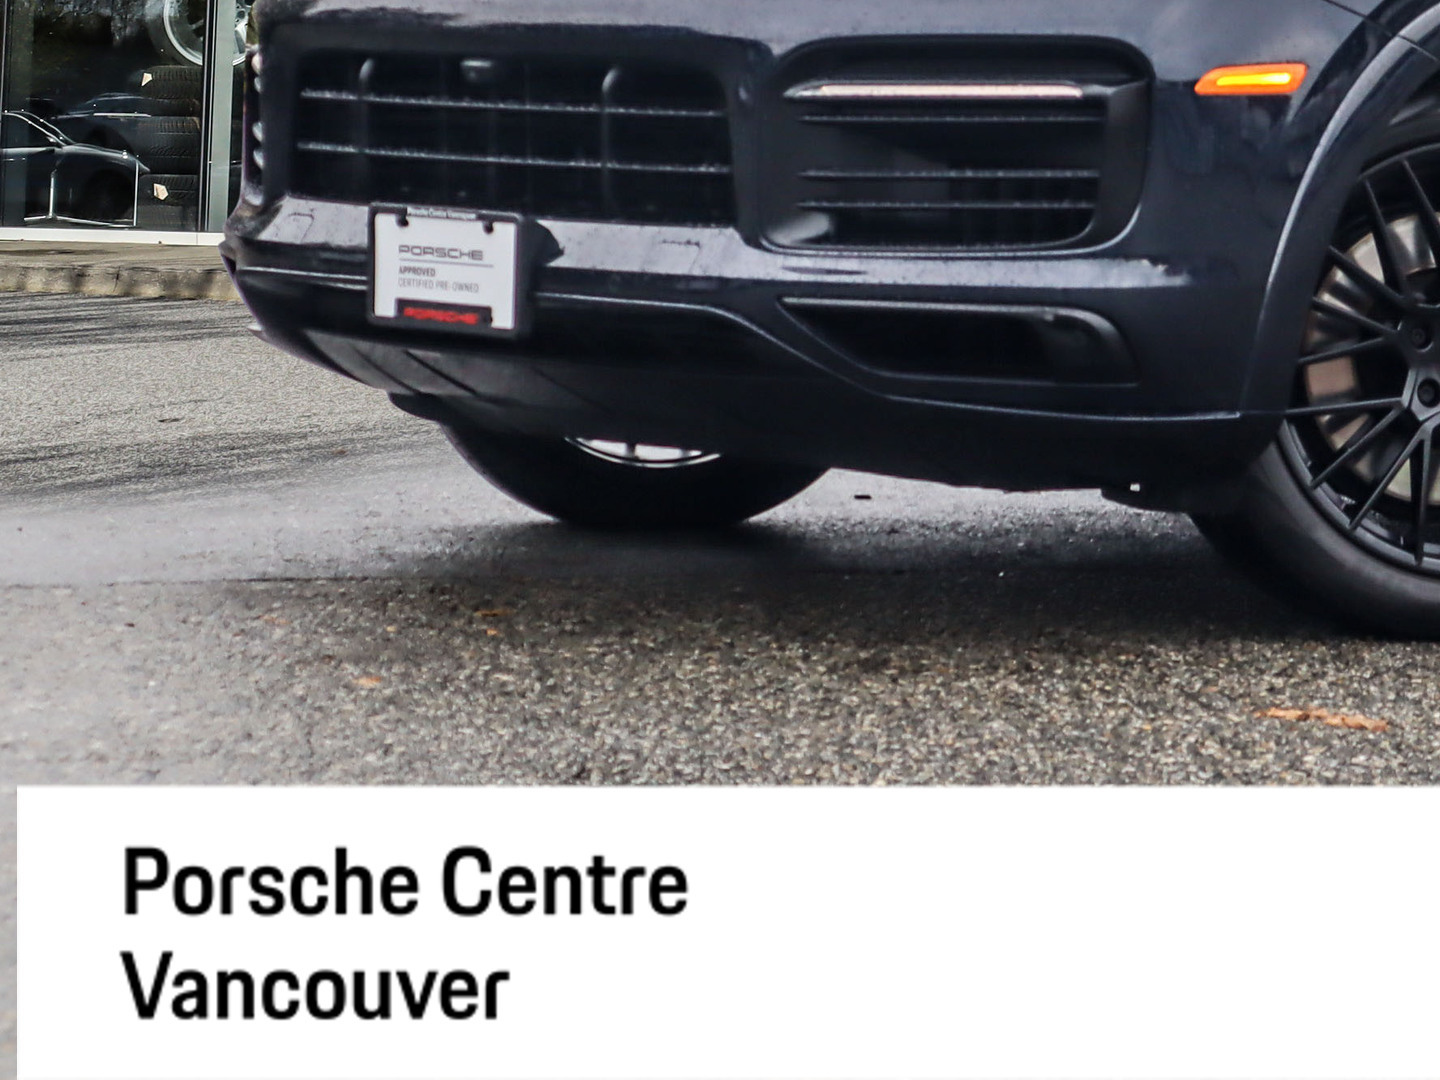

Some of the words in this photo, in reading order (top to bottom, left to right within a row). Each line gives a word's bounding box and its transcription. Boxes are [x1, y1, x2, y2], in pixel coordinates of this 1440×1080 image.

[398, 245, 484, 261] PORSCHE
[399, 266, 436, 277] APPROVED
[398, 277, 434, 290] CERTIFIED
